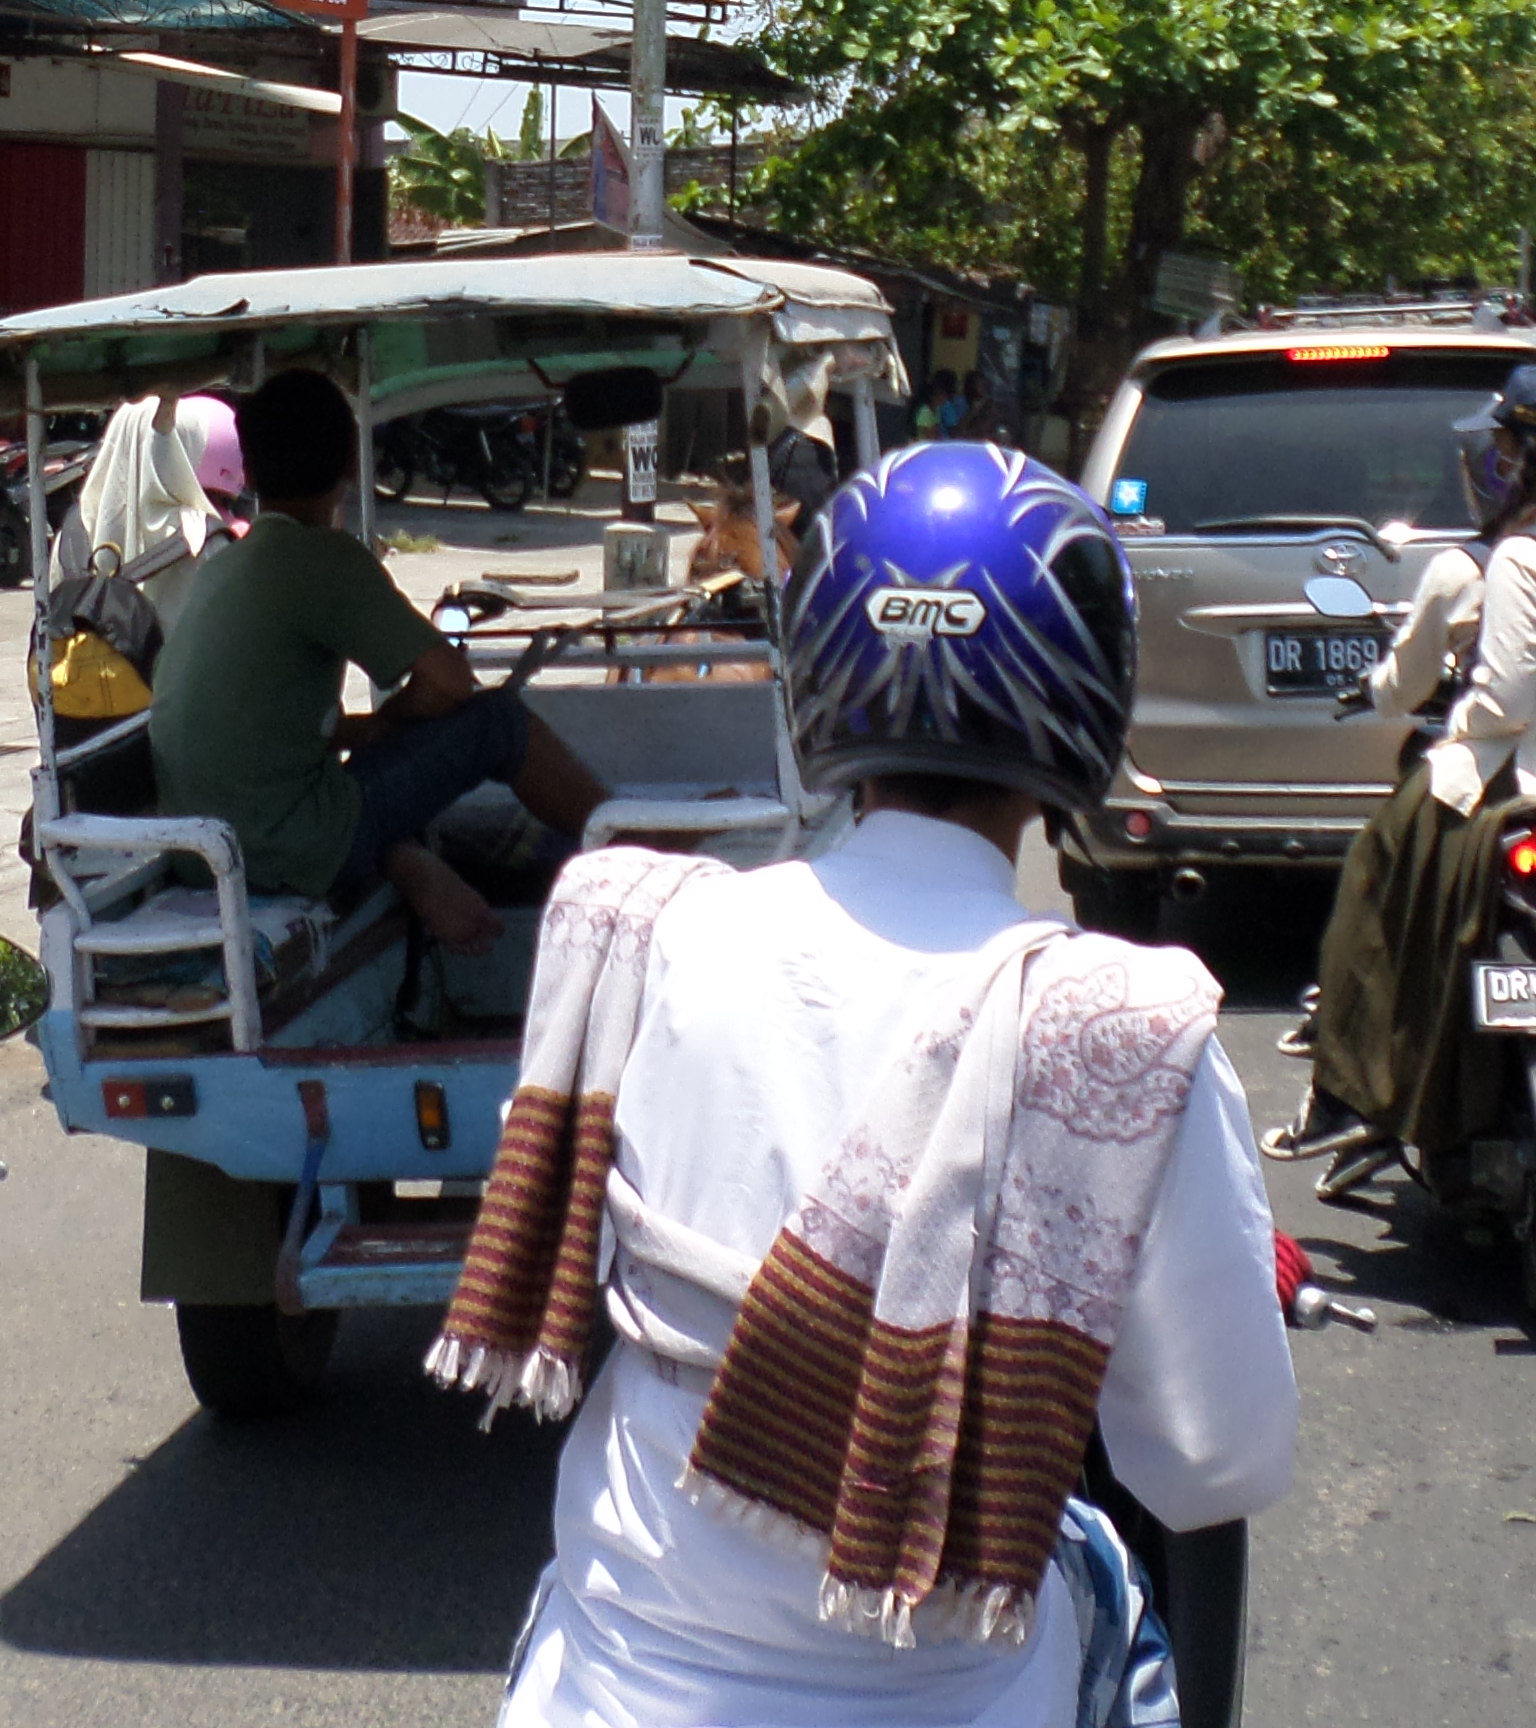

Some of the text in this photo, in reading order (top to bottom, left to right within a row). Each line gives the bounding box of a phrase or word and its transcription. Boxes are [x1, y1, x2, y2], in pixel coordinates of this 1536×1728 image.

[880, 595, 976, 632] BMC
[1268, 637, 1379, 672] DR 1869
[1490, 970, 1528, 1001] DR
